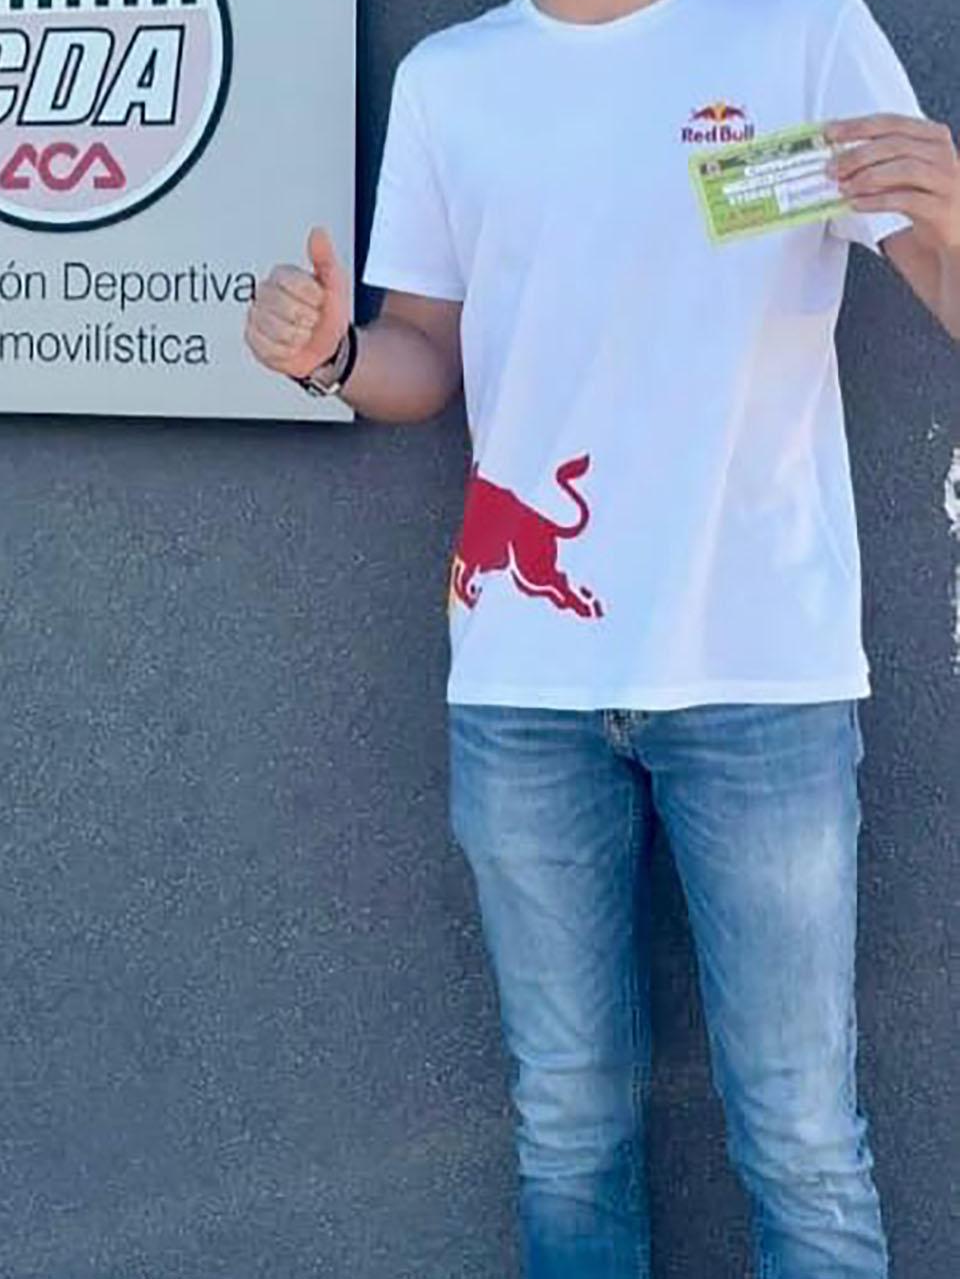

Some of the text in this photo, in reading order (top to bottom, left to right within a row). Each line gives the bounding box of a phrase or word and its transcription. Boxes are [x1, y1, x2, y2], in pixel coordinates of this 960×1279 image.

[681, 123, 755, 144] Red Bull
[63, 261, 257, 310] Deportiva
